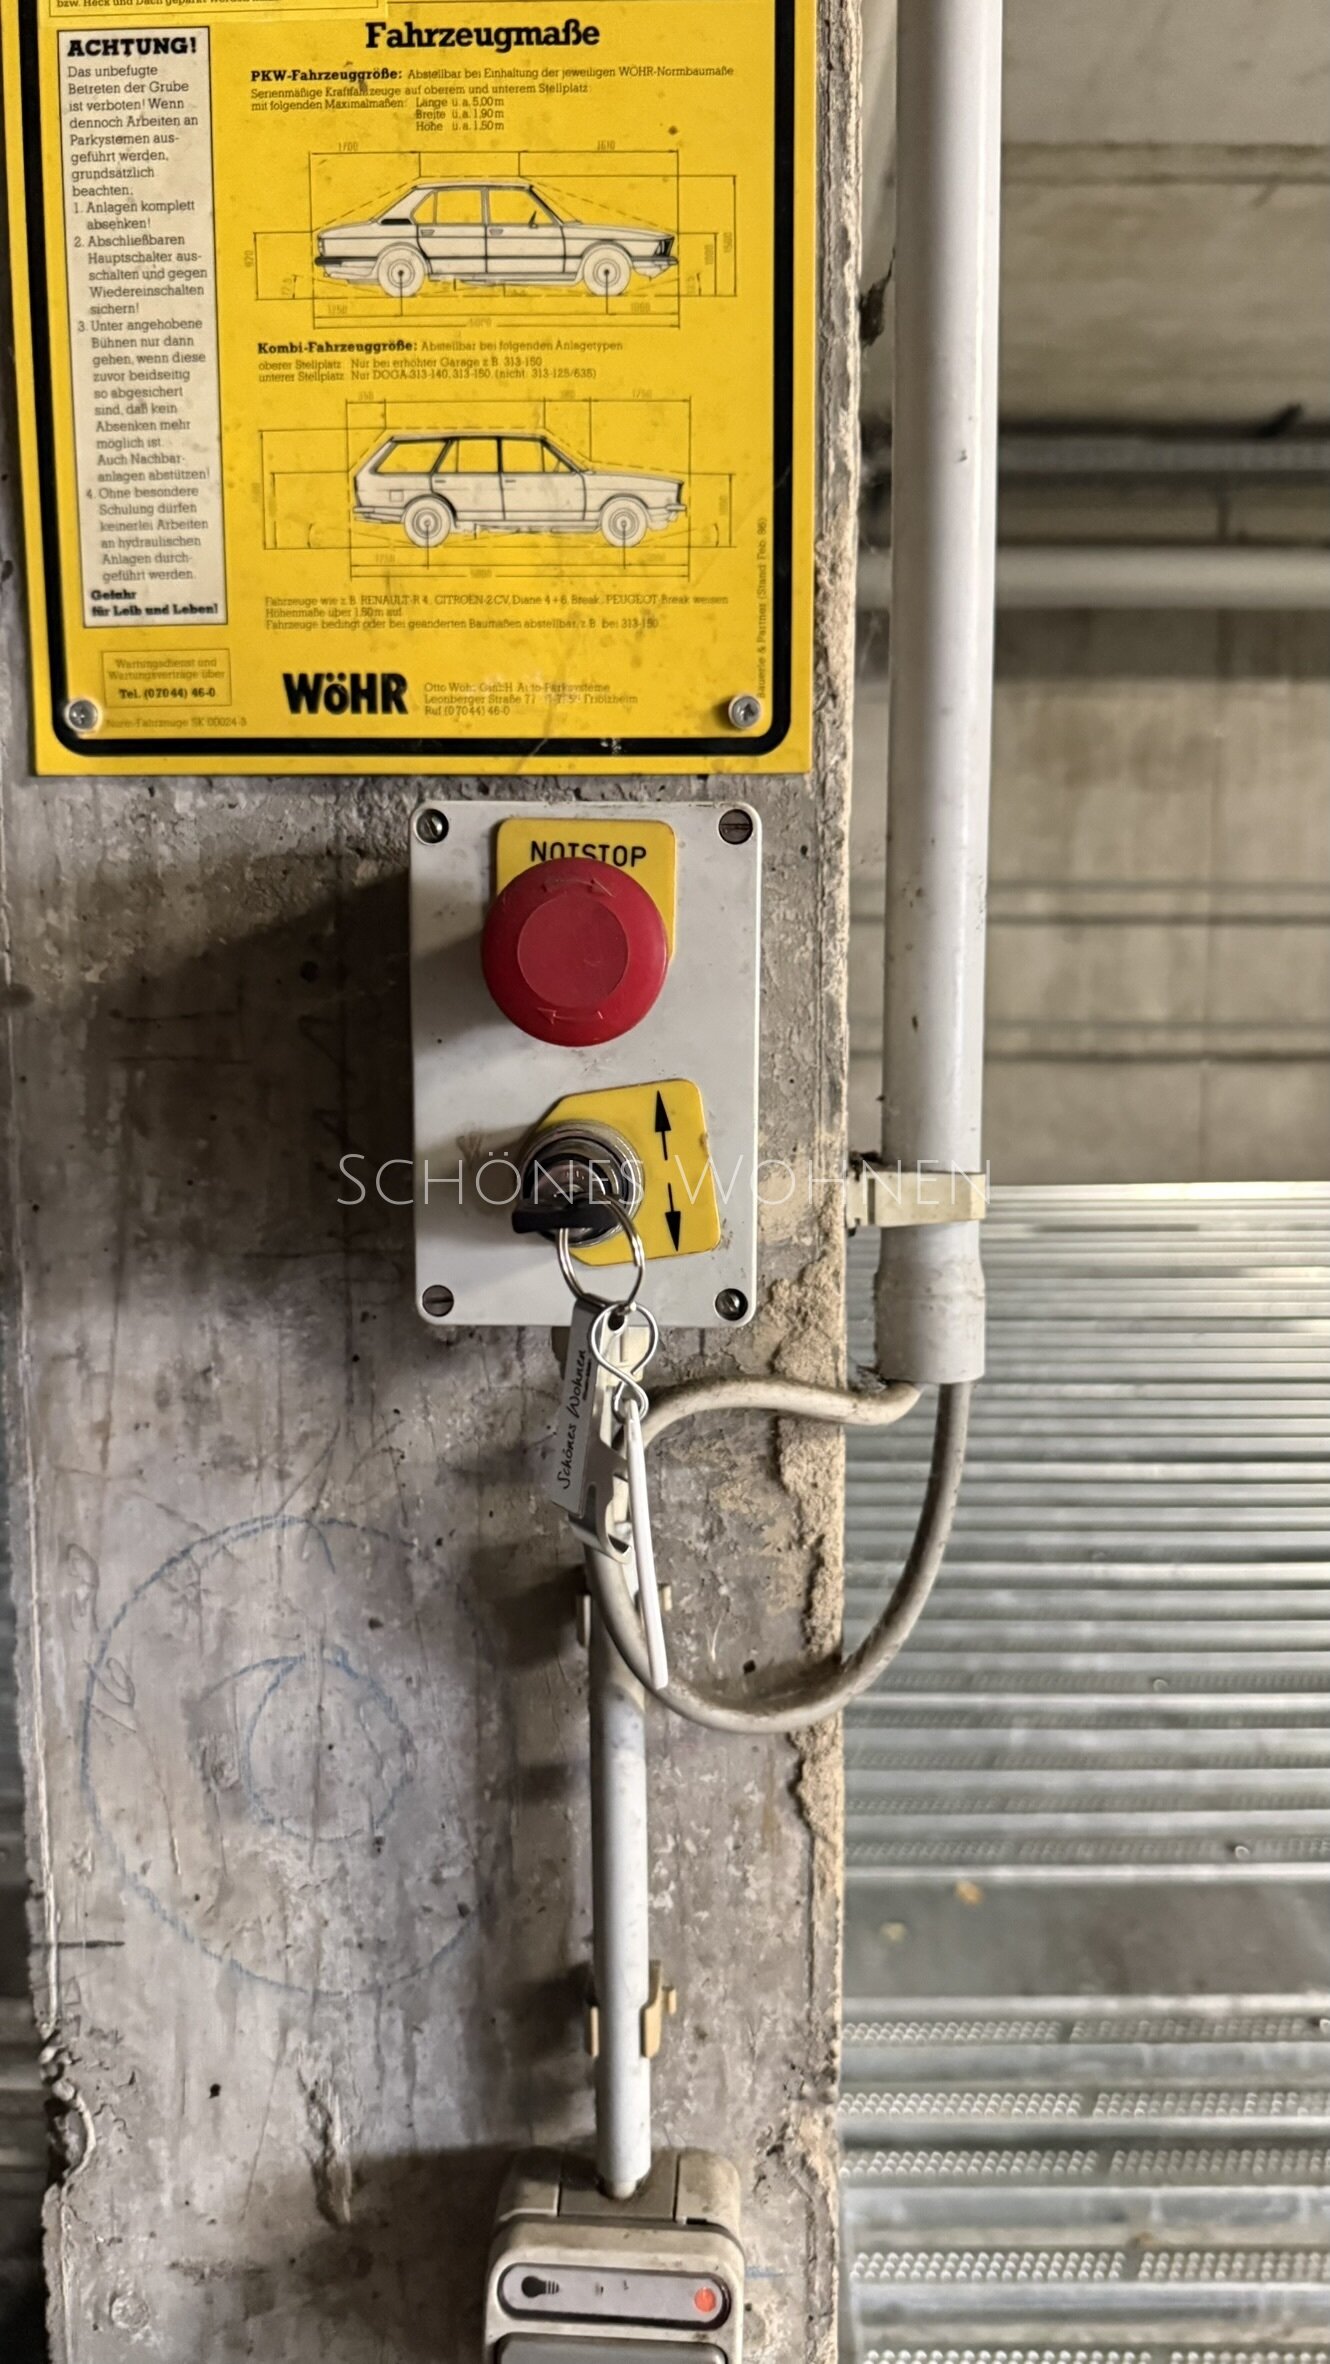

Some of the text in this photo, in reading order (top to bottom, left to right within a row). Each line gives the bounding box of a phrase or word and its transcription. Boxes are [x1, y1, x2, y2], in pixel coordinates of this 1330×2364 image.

[365, 18, 600, 53] Fahrzeugmaße
[67, 36, 197, 57] ACHTUNG!
[67, 64, 158, 78] Das unbefugte
[251, 68, 402, 83] PKW-Fahrzeuggröße:
[408, 68, 461, 79] Abstellbar
[464, 68, 481, 78] bei
[484, 66, 538, 79] Einhaltung
[542, 66, 559, 77] der
[562, 66, 616, 79] jeweiligen
[68, 80, 189, 94] Betreten der Grube
[251, 88, 323, 100] Serienmäßige
[404, 86, 421, 95] auf
[424, 85, 466, 94] oberem
[468, 84, 489, 94] und
[492, 84, 536, 94] unterem
[70, 98, 184, 112] ist verboten! Wenn
[252, 97, 448, 112] mit folgenden Länge
[416, 110, 446, 120] Breite
[70, 116, 198, 128] dennoch Arbeiten an
[416, 120, 444, 131] Höhe
[70, 132, 180, 148] Parkystemen aus-
[71, 151, 115, 166] geführt
[72, 167, 154, 182] grundsätzlich
[86, 202, 138, 215] Anlagen
[141, 200, 195, 214] komplett
[87, 220, 150, 230] absenken!
[74, 235, 184, 247] 2. Abschließbaren
[88, 252, 202, 266] Hauptschalter aus-
[88, 268, 208, 282] schalten und gegen
[89, 284, 204, 298] Wiedereinschalten
[90, 303, 140, 316] sichern!
[90, 320, 124, 331] Unter
[127, 319, 202, 332] angehobene
[92, 336, 194, 348] Bühnen nur dann
[258, 340, 418, 354] Kombi-Fahrzeuggröße:
[480, 341, 496, 350] bei
[500, 340, 553, 352] folgenden
[556, 340, 623, 352] Anlagetypen
[92, 352, 206, 368] gehen, wenn diese
[258, 361, 292, 371] oberer
[352, 360, 370, 368] Nur
[373, 359, 390, 368] bei
[440, 358, 480, 369] Garage
[93, 370, 190, 382] zuvor beidseitig
[259, 373, 294, 382] unterer
[352, 371, 370, 380] Nur
[94, 386, 183, 399] so abgesichert
[94, 403, 178, 416] sind, daß kein
[96, 420, 190, 432] Absenken mehr
[96, 438, 145, 450] möglich
[98, 453, 185, 466] Auch Nachbar-
[98, 468, 210, 484] anlagen abstützen!
[98, 488, 131, 498] Ohne
[135, 486, 198, 498] besondere
[100, 502, 198, 516] Schulung dürfen
[100, 518, 208, 532] keinerlei Arbeiten
[101, 536, 200, 550] an hydraulischen
[102, 552, 192, 566] Anlagen durch-
[102, 570, 146, 584] geführt
[90, 588, 136, 600] Gefahr
[266, 596, 317, 608] Fahrzeuge
[92, 603, 218, 616] für Leib und Leben!
[266, 619, 318, 631] Fahrzeuge
[362, 619, 386, 630] oder
[389, 618, 406, 629] bei
[469, 618, 522, 629] Baumaßen
[198, 658, 217, 668] und
[119, 687, 216, 700] Tel. 46-0
[424, 682, 446, 692] Otto
[424, 694, 485, 706] Leonberger
[488, 694, 522, 704] Straße
[425, 706, 442, 716] Ruf
[530, 841, 647, 868] NOTSTOP
[556, 1349, 586, 1490] Schönes Wohnen
